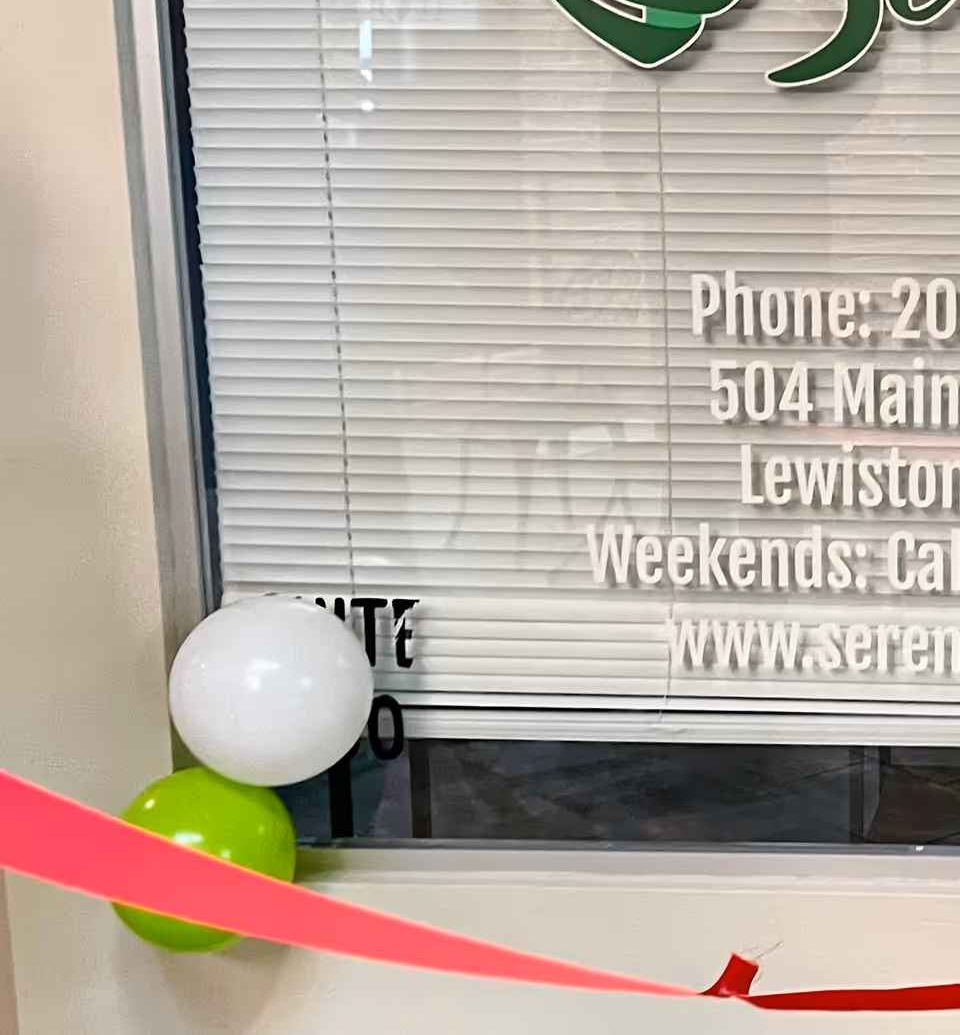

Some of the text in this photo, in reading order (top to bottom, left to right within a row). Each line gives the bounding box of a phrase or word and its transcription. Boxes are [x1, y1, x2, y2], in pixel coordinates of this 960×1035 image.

[691, 270, 871, 338] Phone:
[710, 360, 814, 422] 504
[834, 356, 959, 425] Main
[586, 522, 867, 589] Weekends:
